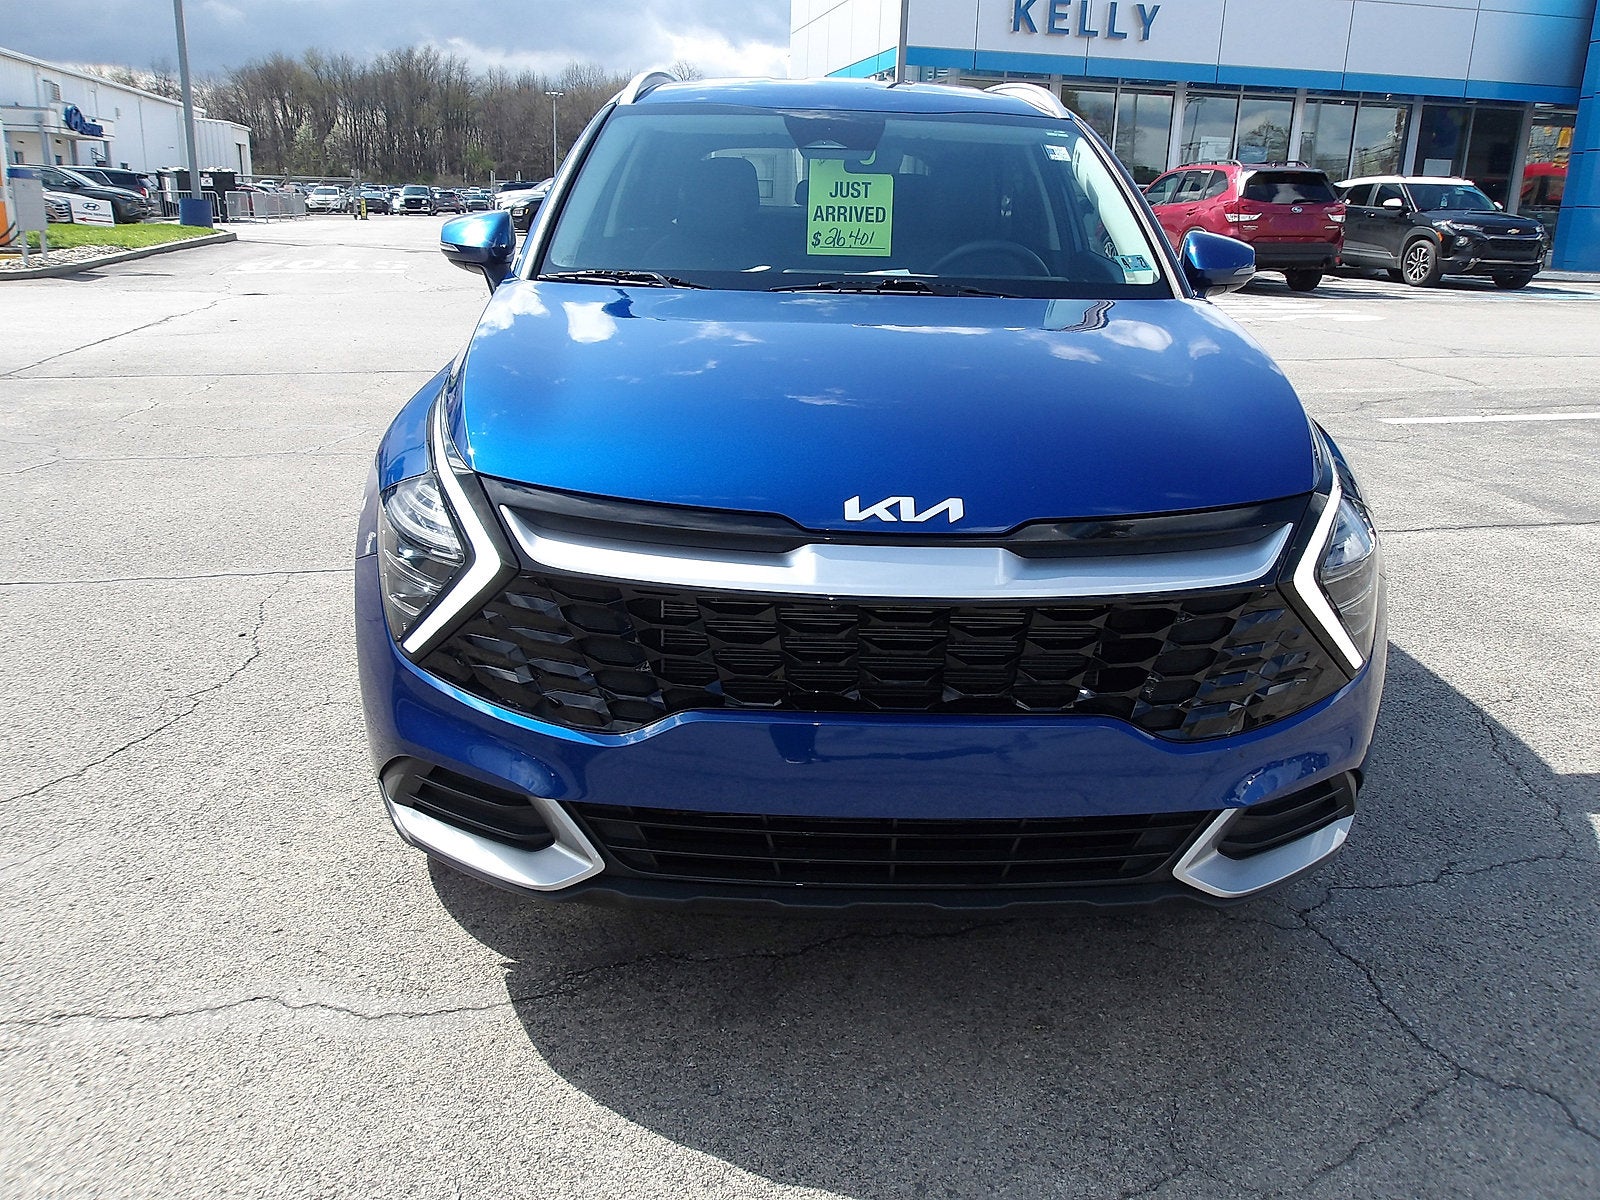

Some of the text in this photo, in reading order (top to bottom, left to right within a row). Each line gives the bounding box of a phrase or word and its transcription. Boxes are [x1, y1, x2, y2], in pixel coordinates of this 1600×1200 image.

[1012, 0, 1161, 41] KELLY
[829, 182, 871, 198] JUST
[812, 205, 886, 223] ARRIVED
[843, 495, 965, 524] KIA
